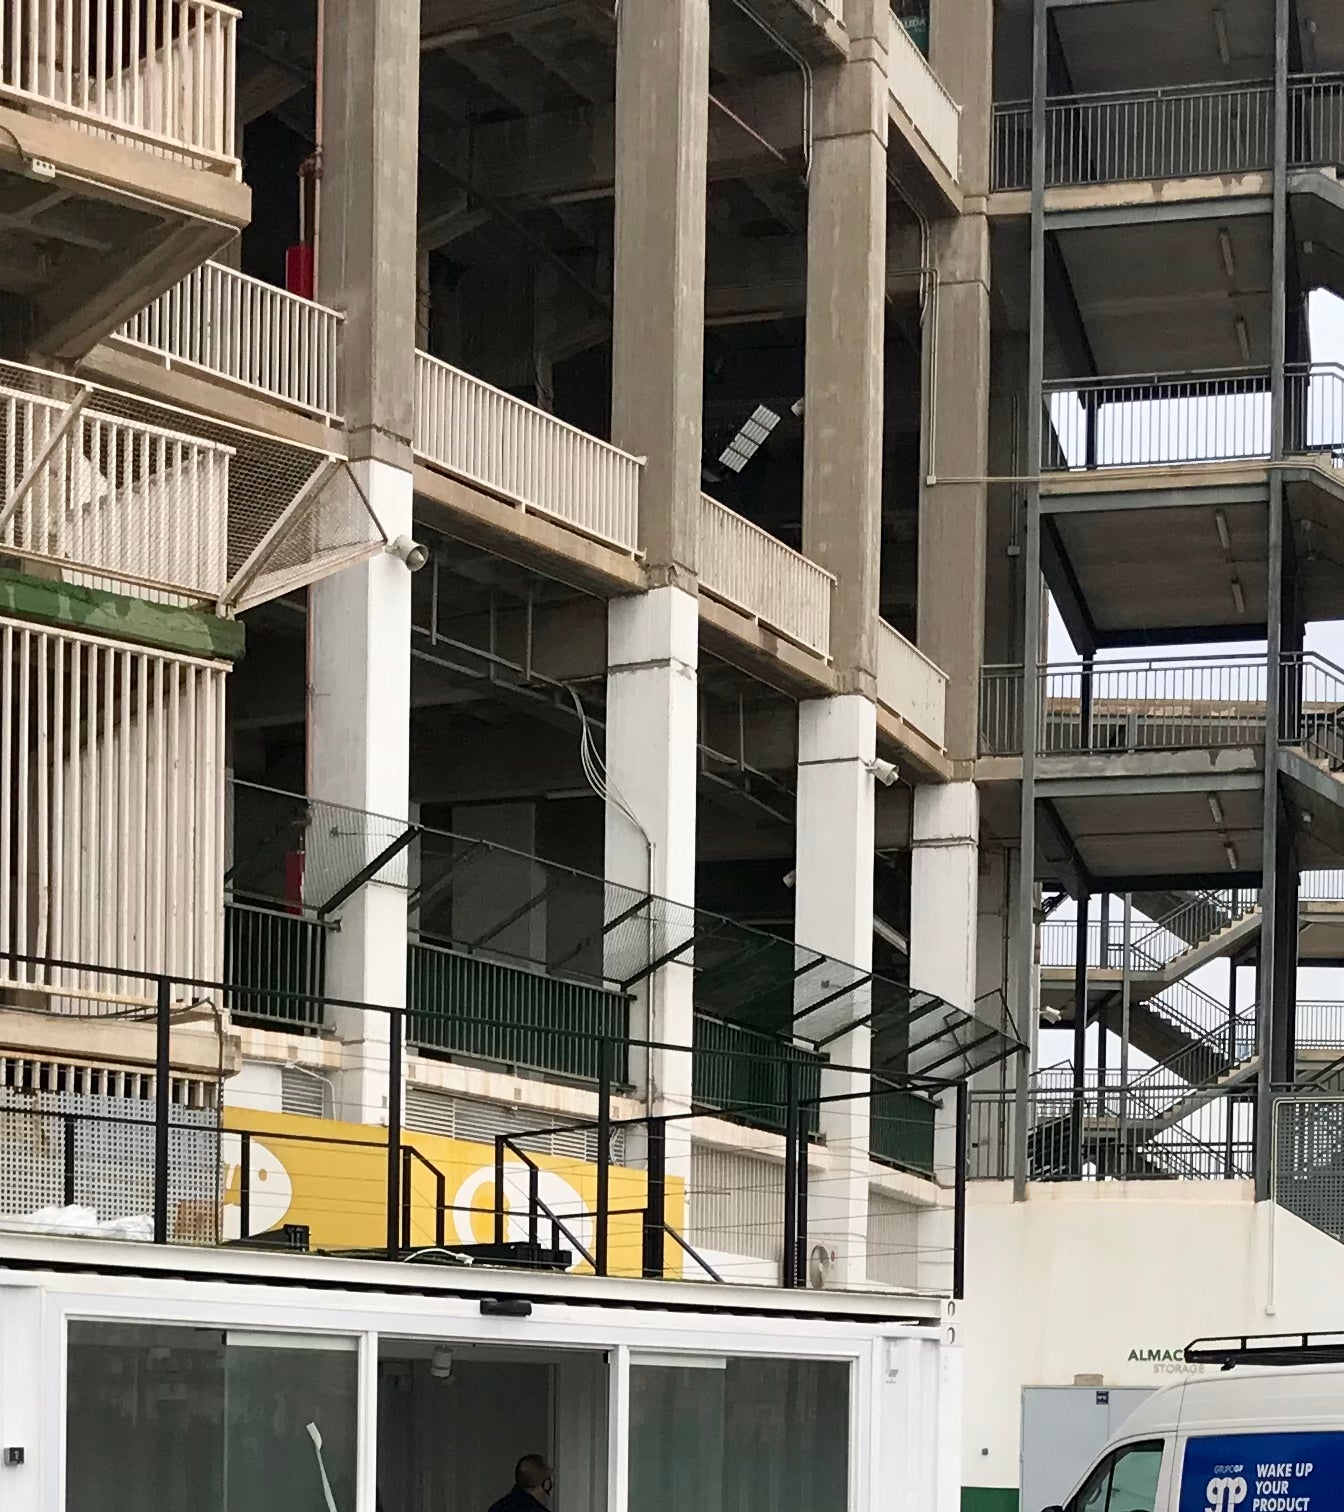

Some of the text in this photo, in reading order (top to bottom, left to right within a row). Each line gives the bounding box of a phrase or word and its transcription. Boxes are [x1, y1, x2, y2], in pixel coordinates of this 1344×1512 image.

[1127, 1349, 1184, 1361] ALMAC
[1153, 1364, 1205, 1374] STORAGE
[1256, 1462, 1314, 1478] WAKE UP
[1255, 1480, 1289, 1495] YOUR
[1252, 1497, 1311, 1512] PRODUCT
